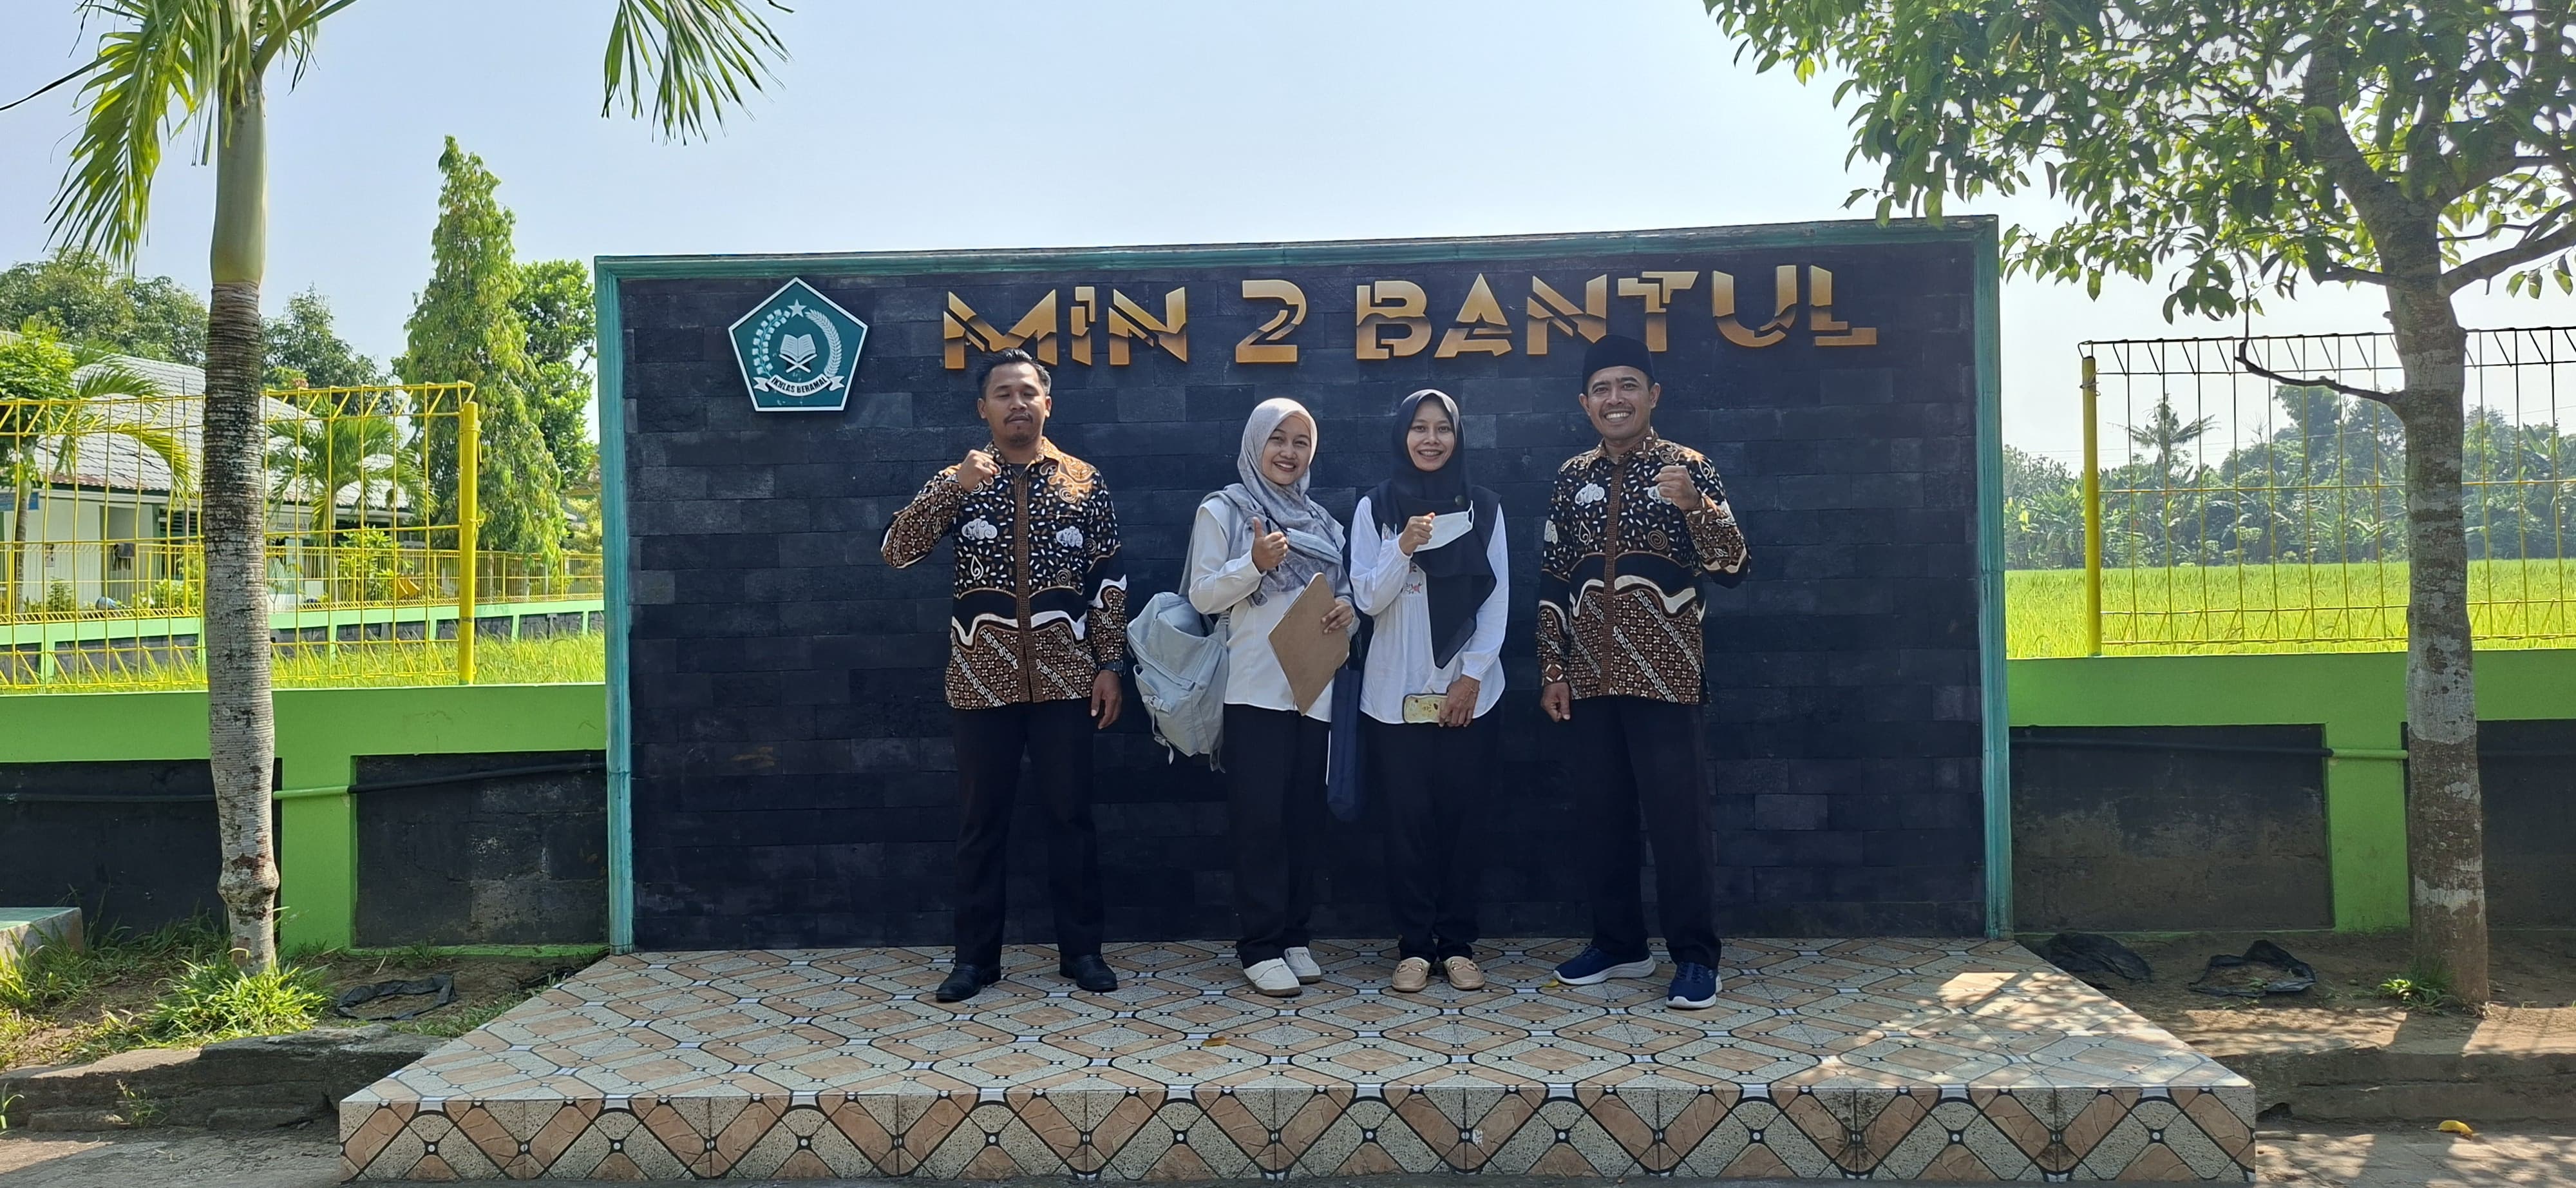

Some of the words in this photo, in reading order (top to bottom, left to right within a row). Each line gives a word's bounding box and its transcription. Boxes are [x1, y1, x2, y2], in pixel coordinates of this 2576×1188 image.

[943, 285, 1188, 369] MIN
[1235, 279, 1306, 363] 2
[1356, 264, 1878, 360] BANTUL
[771, 377, 795, 393] IKHLAS
[797, 377, 828, 394] BERAMAL
[278, 517, 307, 529] madrah
